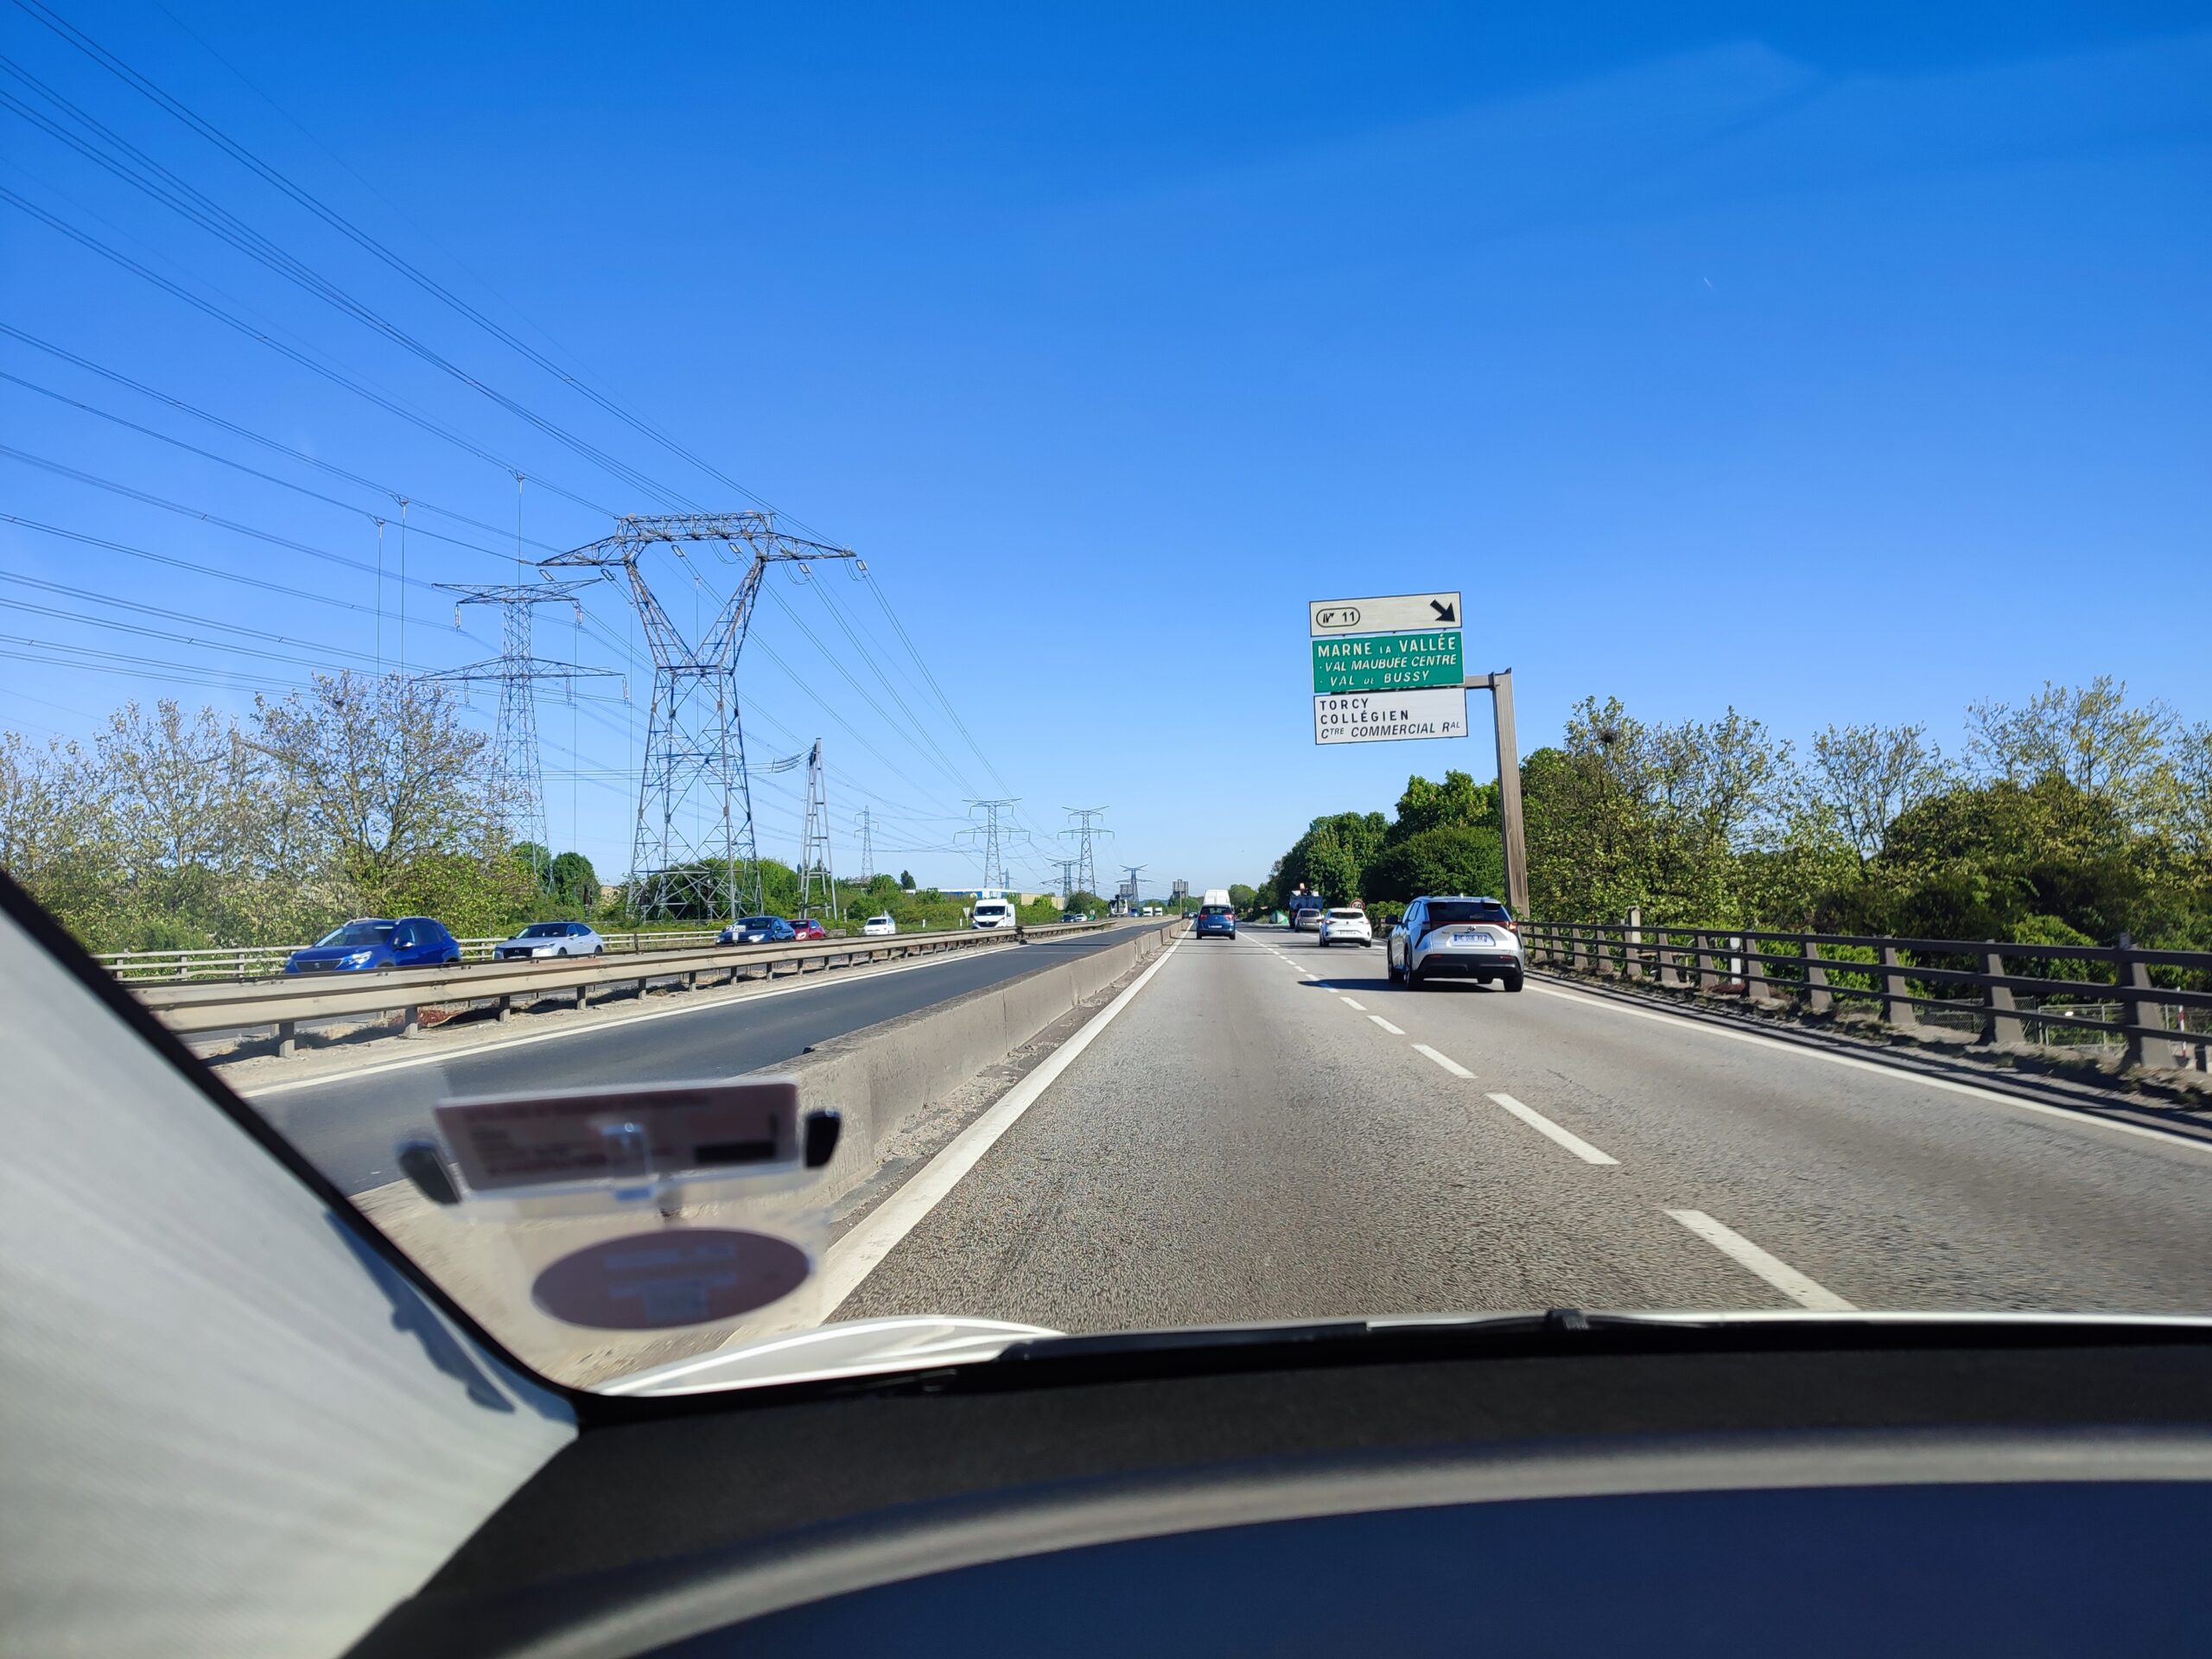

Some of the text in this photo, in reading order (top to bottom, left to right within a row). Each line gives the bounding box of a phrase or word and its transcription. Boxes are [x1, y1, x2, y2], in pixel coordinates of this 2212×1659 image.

[1342, 611, 1356, 622] 11
[1318, 642, 1372, 658] MARNE
[1399, 634, 1456, 653] VALLÉE
[1325, 653, 1457, 672] VAL MAUBUÉE CENTRE
[1330, 675, 1354, 686] VAL
[1384, 670, 1429, 683] BUSSY
[1320, 698, 1369, 711] TORCY
[1320, 710, 1408, 725] COLLÉGIEN
[1351, 722, 1435, 738] COMMERCIAL
